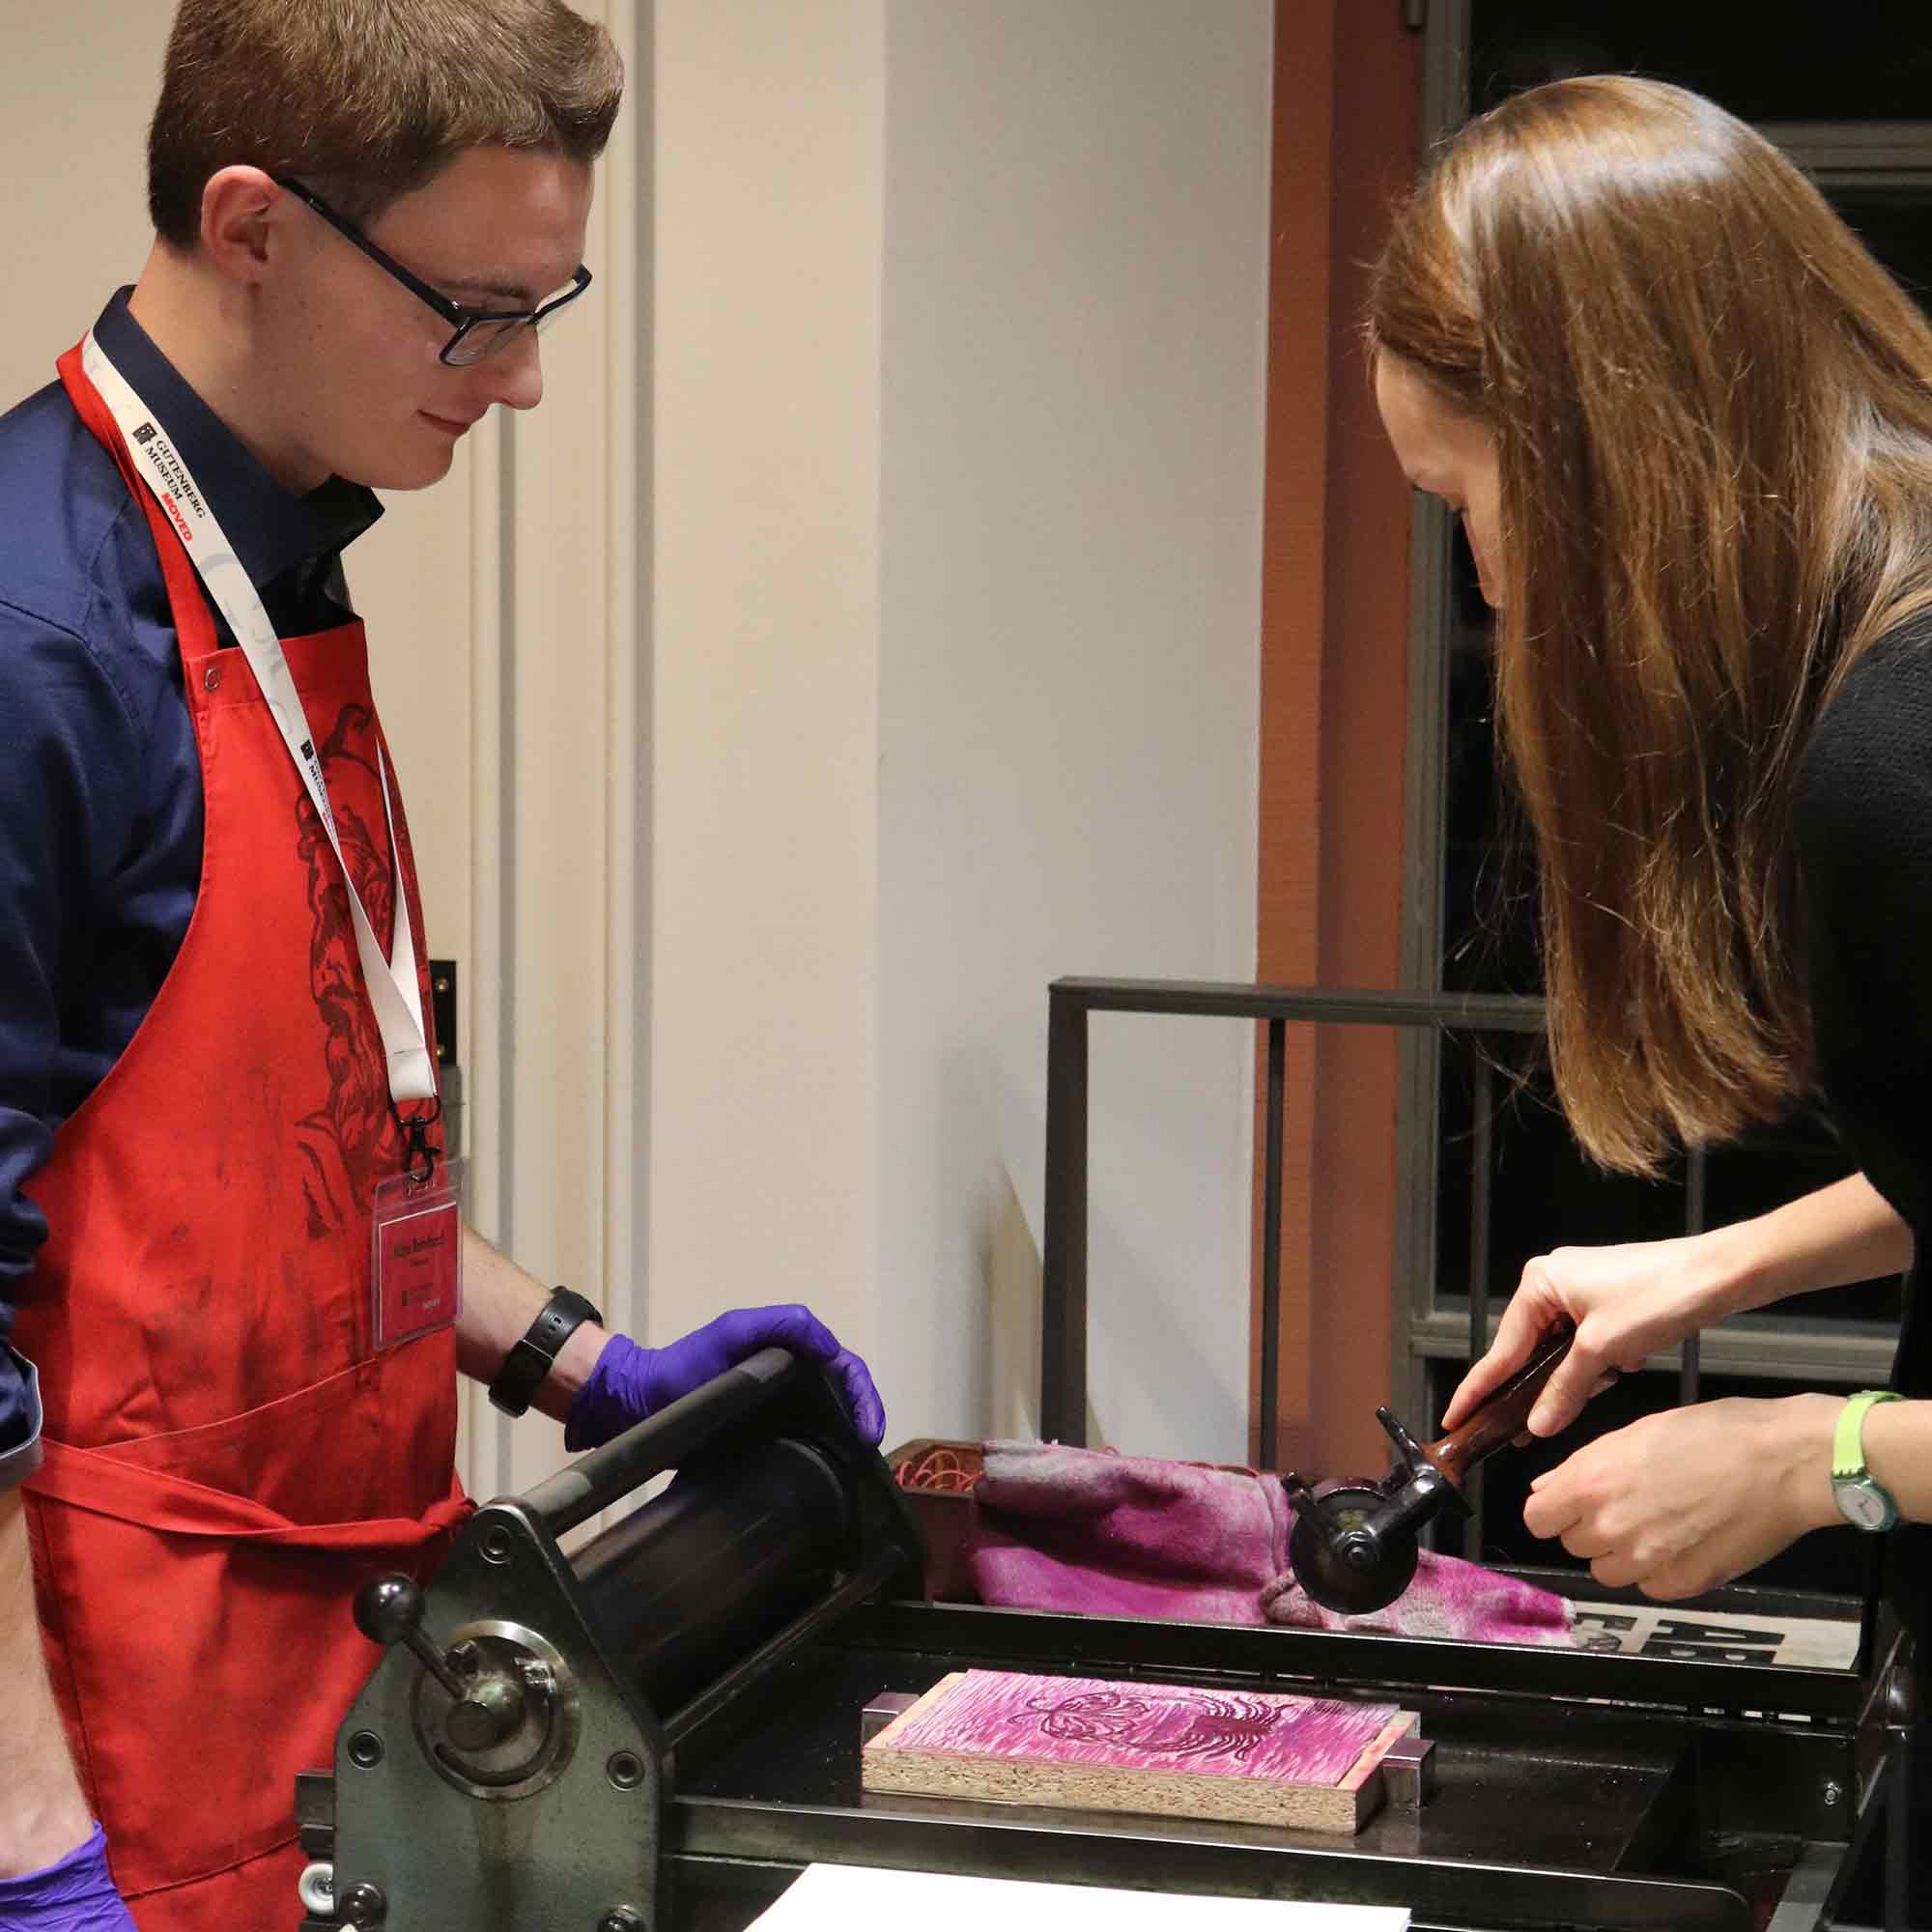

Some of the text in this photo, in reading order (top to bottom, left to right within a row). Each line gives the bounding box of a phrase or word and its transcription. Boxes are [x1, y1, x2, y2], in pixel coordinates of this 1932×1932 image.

[145, 445, 183, 500] MUSEUM
[156, 440, 206, 518] GUTENBERG
[161, 493, 193, 541] MOVED
